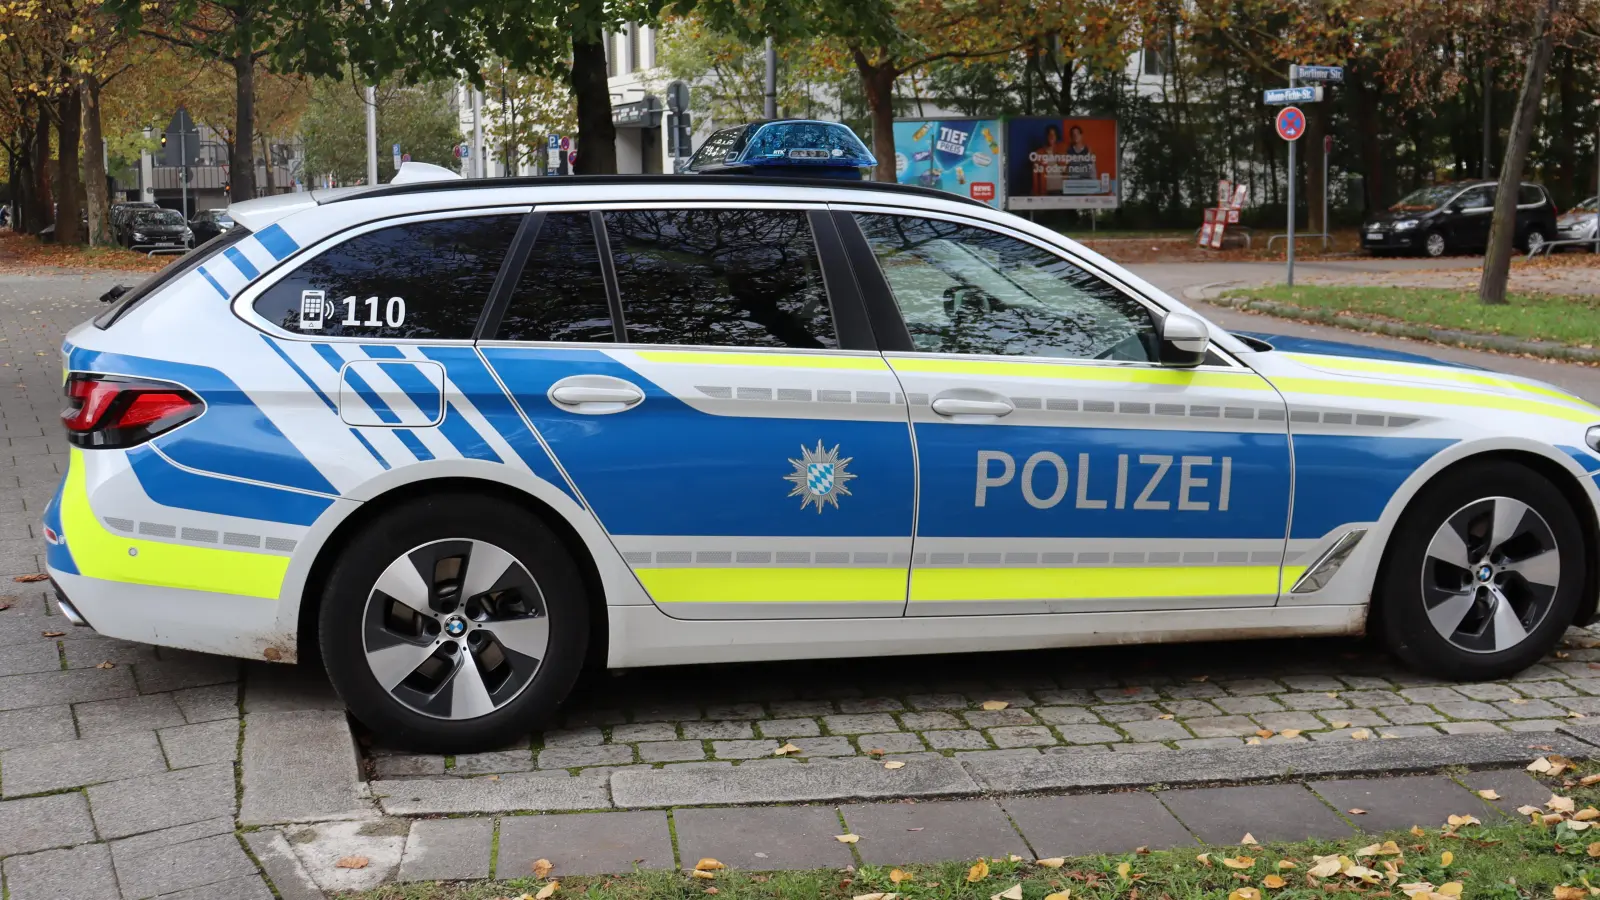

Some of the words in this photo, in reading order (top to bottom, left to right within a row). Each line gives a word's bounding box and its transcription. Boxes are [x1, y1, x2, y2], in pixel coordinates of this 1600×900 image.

[940, 126, 969, 145] TIEF
[940, 141, 962, 154] PREIS
[1029, 151, 1097, 164] Organspende
[1033, 163, 1045, 173] Ja
[1046, 163, 1067, 173] oder
[1068, 163, 1093, 173] nein?
[342, 296, 406, 328] 110
[974, 450, 1232, 511] POLIZEI
